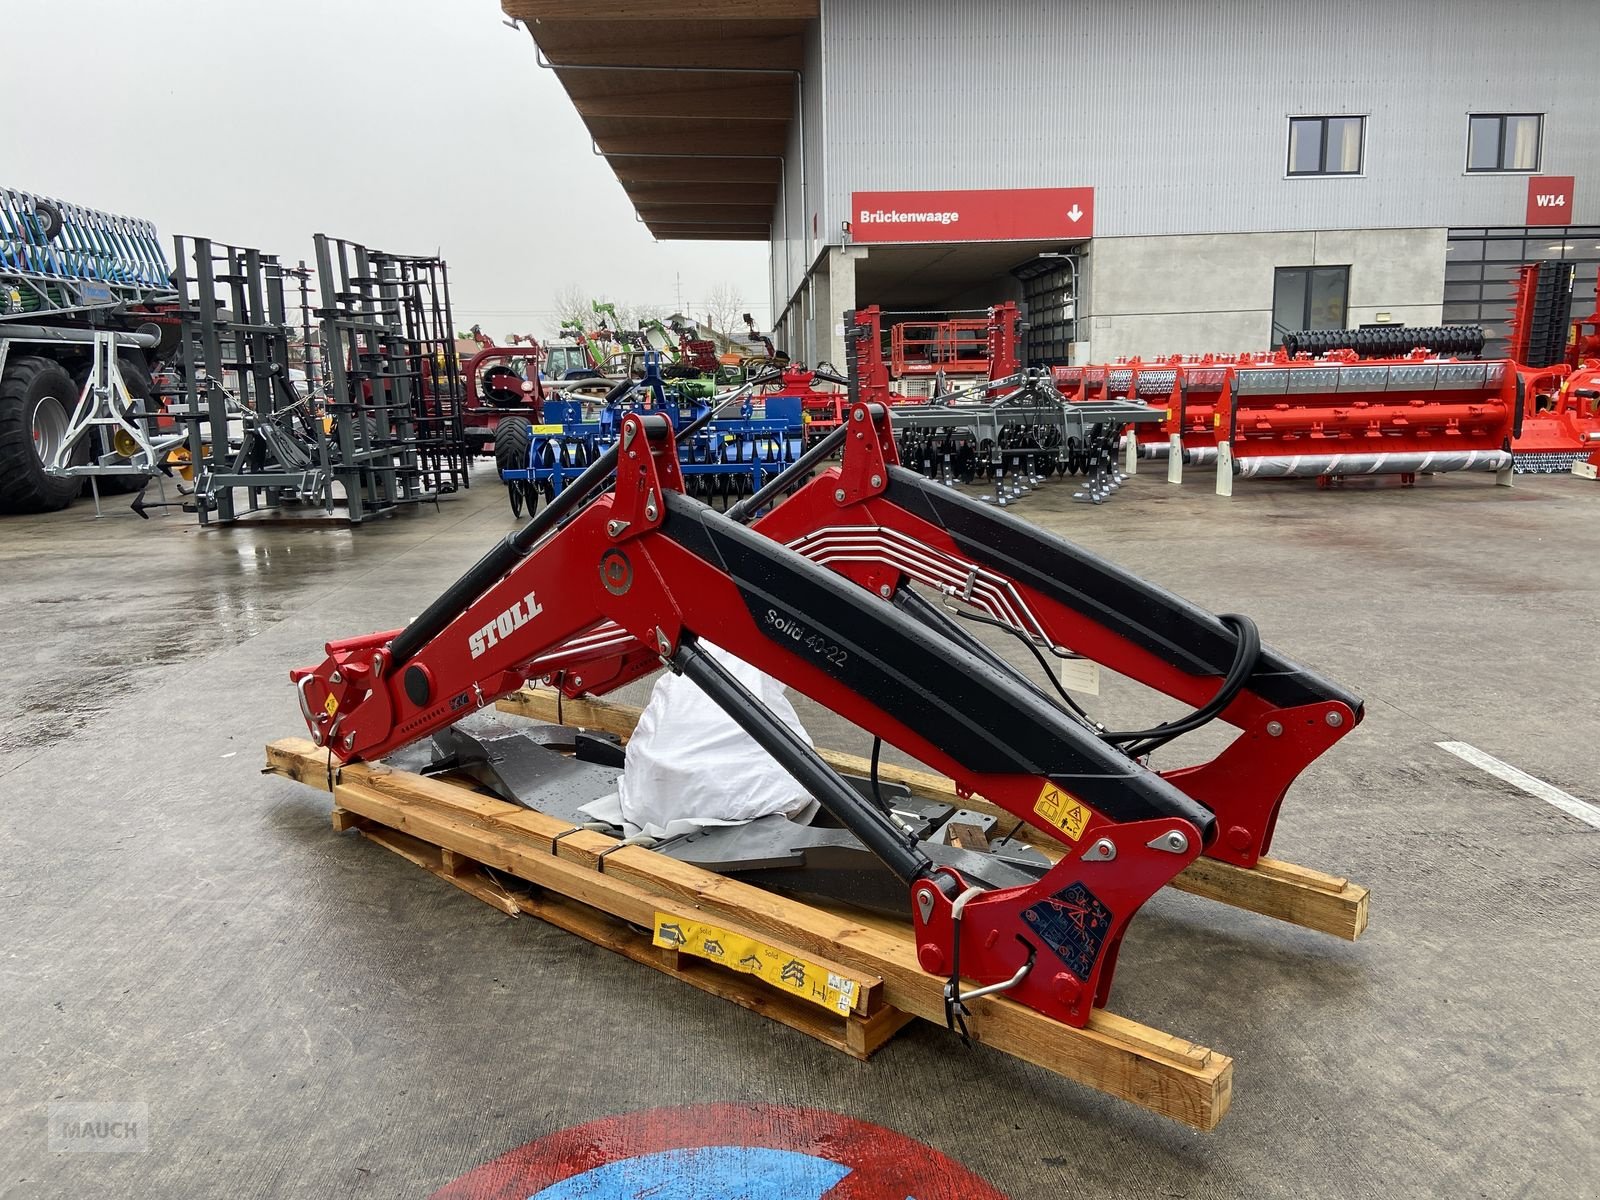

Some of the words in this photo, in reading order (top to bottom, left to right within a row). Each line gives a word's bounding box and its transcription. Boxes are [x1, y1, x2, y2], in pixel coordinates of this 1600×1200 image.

[1537, 194, 1565, 207] W14
[860, 210, 960, 224] Brückenwaage
[468, 591, 543, 660] STOLL
